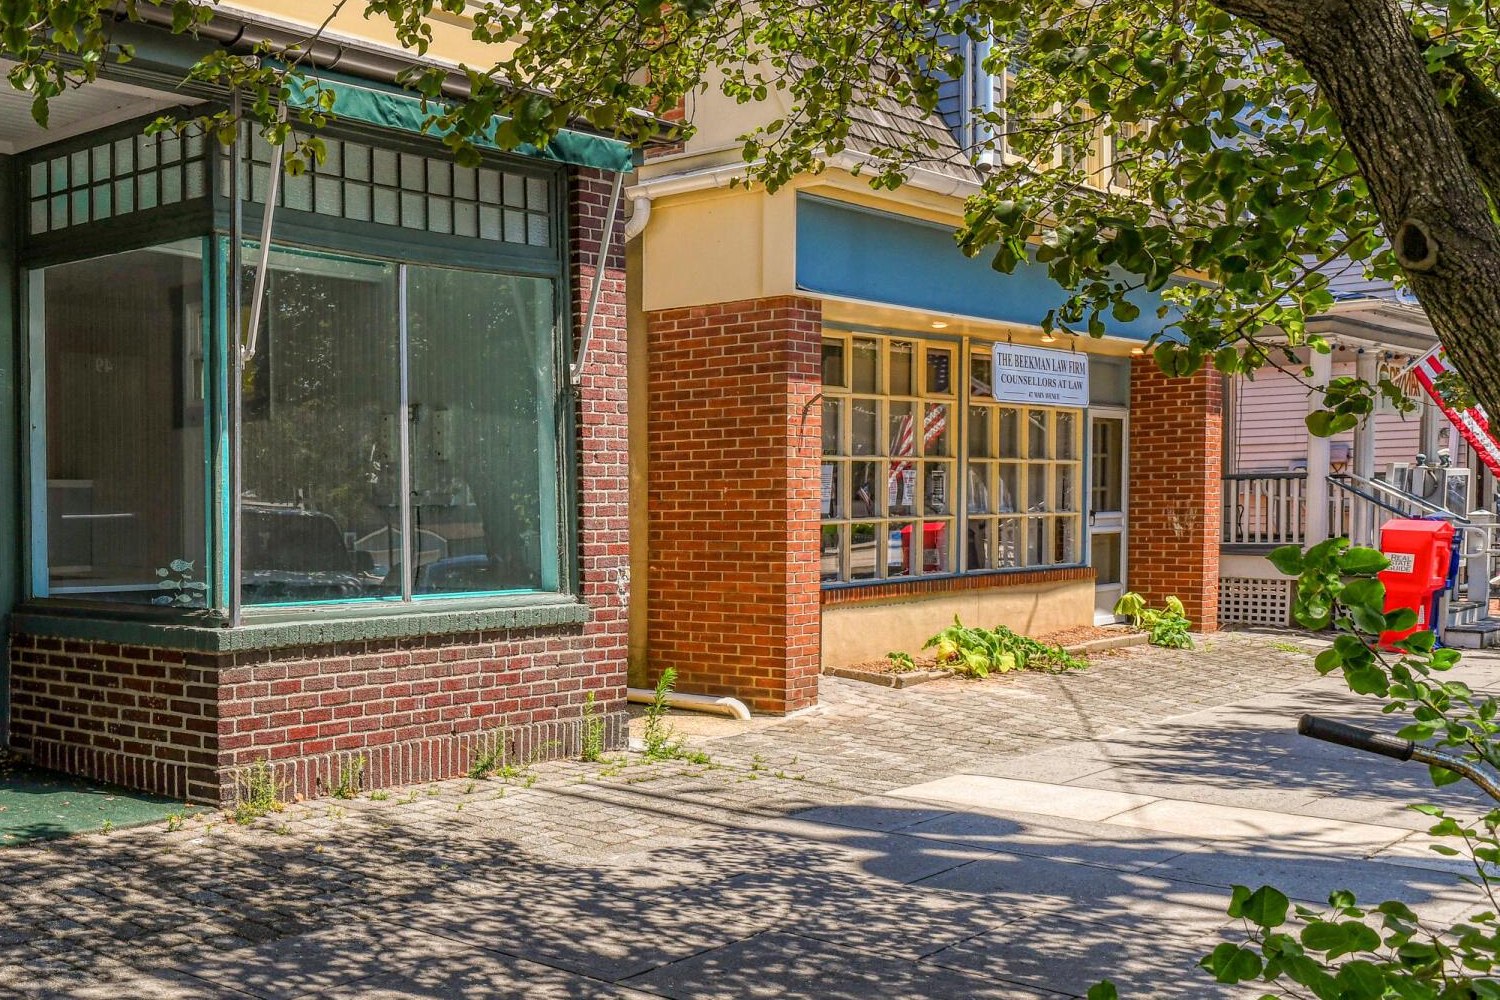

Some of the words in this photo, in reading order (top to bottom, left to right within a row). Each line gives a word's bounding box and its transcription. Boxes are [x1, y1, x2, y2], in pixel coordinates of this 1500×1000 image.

[997, 352, 1013, 367] THE
[1014, 354, 1051, 371] BEEKMAN
[1052, 358, 1067, 373] LAW
[1068, 360, 1086, 375] FIRM
[1000, 374, 1057, 388] COUNSELLORS
[1058, 379, 1067, 389] AT
[1068, 381, 1084, 390] LAW
[1391, 554, 1412, 562] REAL
